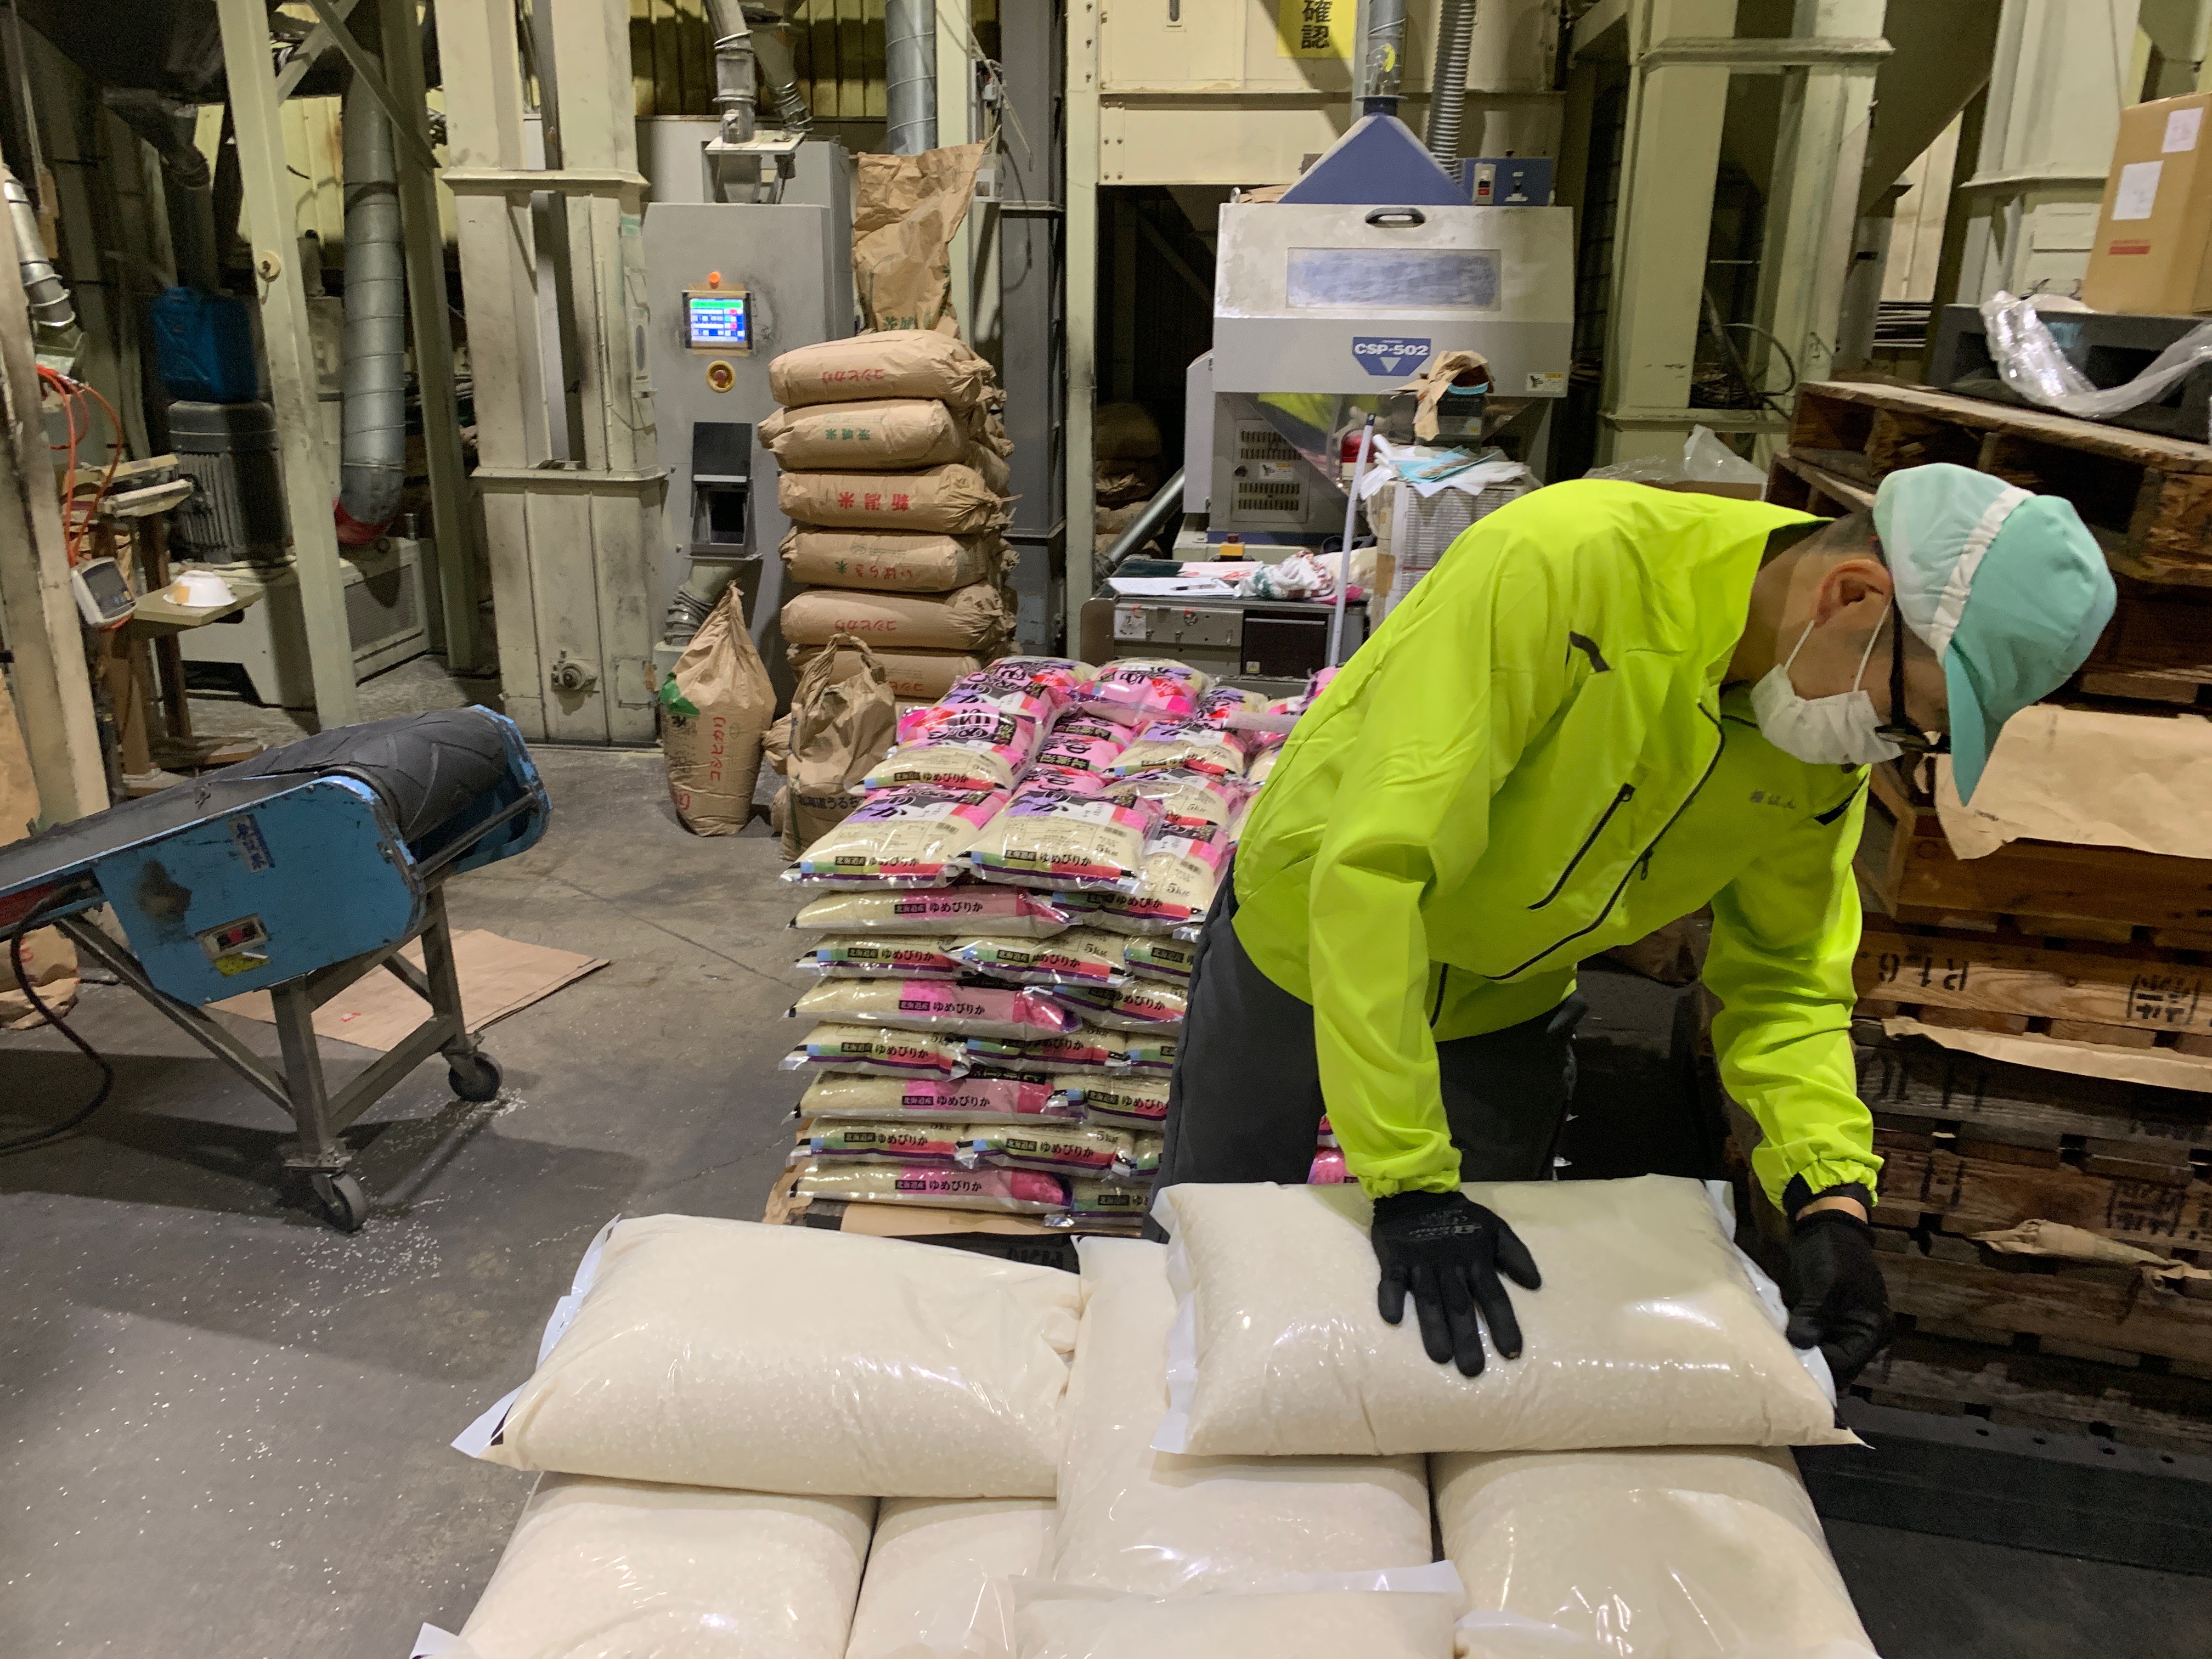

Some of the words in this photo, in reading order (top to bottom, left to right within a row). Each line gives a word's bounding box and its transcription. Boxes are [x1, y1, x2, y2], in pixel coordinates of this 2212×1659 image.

[1301, 0, 1332, 49] 確認
[1355, 343, 1429, 356] CSP-502
[821, 369, 885, 384] コシヒカリ
[825, 428, 871, 441] 茨城米
[837, 492, 910, 512] 新潟米
[834, 619, 896, 632] コシヒカリ
[888, 681, 923, 692] コシヒ
[798, 794, 859, 809] 北海道うるち
